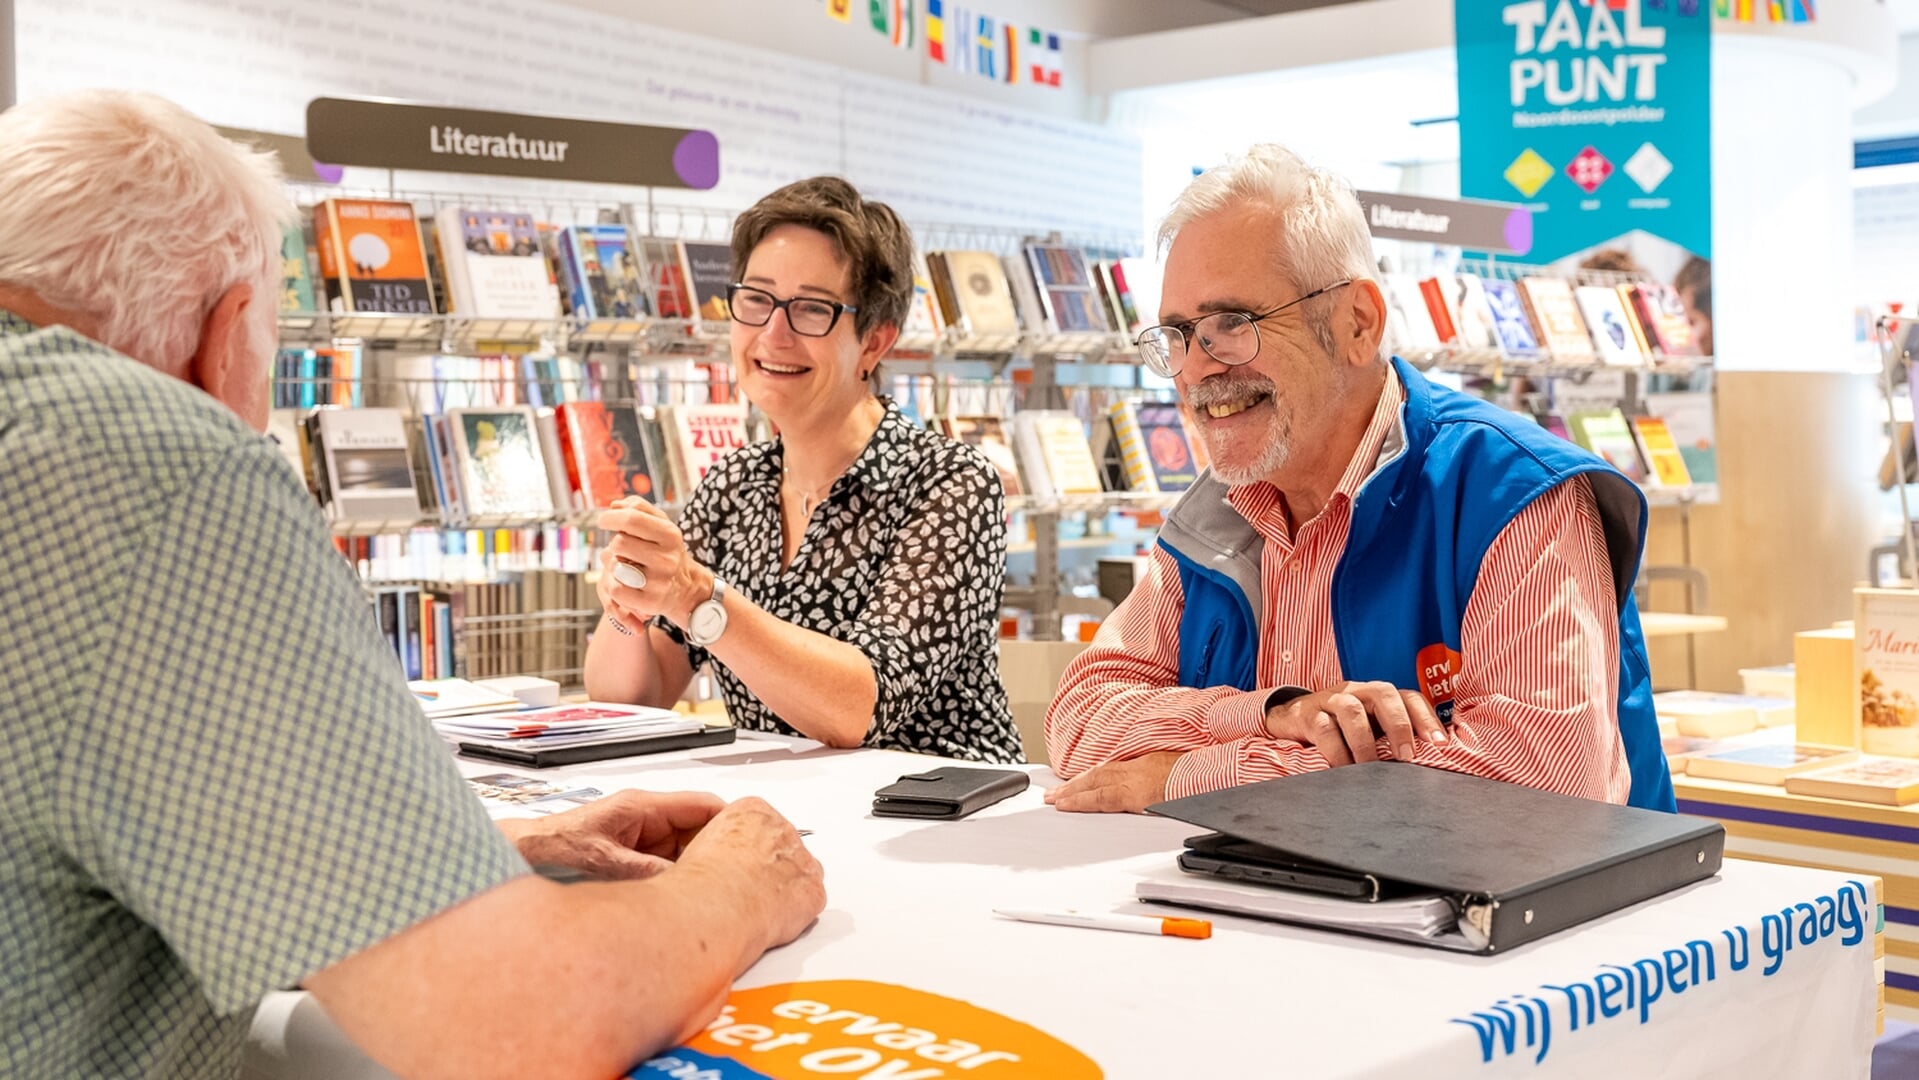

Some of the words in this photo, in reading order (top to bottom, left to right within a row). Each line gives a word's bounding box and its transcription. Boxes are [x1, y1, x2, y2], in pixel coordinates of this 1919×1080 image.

[1503, 0, 1666, 54] TAAL
[1510, 53, 1667, 107] PUNT
[1512, 105, 1664, 129] Noordoostpolder
[430, 125, 569, 163] Literatuur
[1371, 204, 1450, 234] Literatuur
[356, 299, 431, 313] DEKKER
[369, 283, 411, 300] TED
[1450, 996, 1551, 1065] wij
[1722, 926, 1749, 971] u
[772, 1000, 1020, 1068] ervaar
